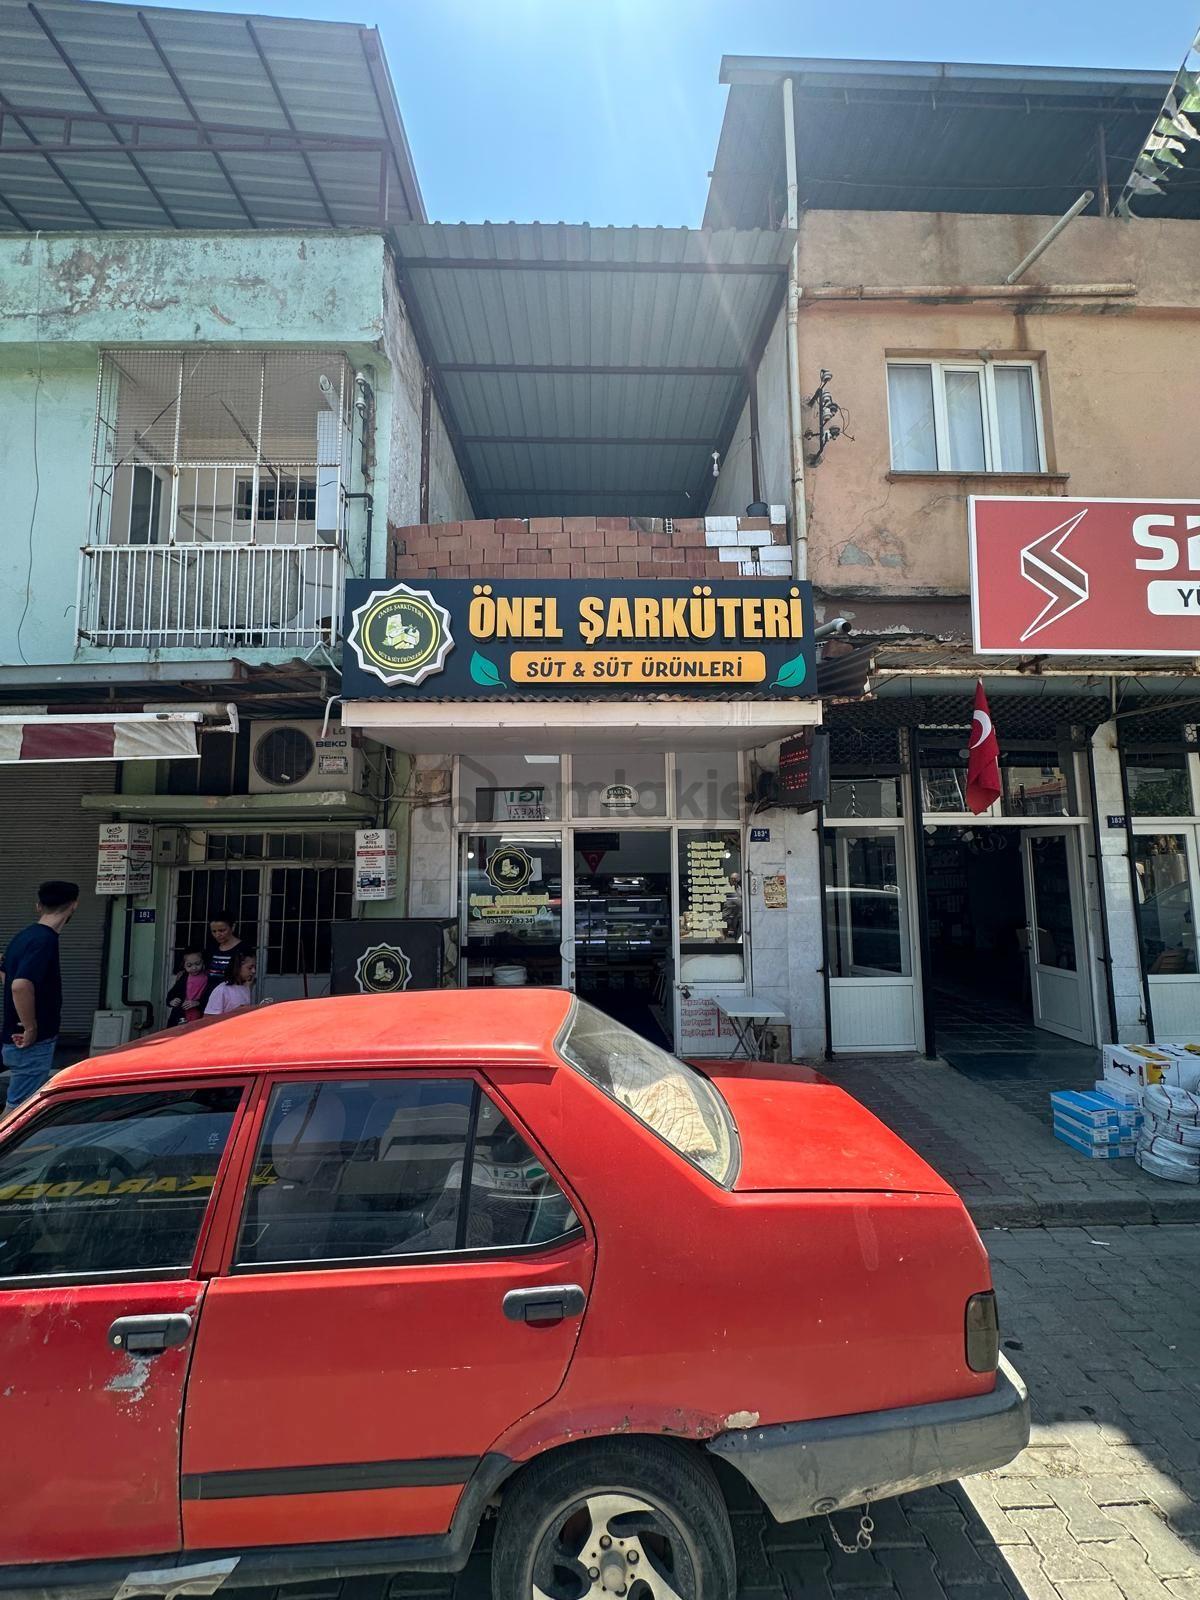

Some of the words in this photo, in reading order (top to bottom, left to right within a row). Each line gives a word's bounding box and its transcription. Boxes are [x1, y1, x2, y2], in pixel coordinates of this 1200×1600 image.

[468, 585, 564, 639] ÖNEL
[579, 585, 804, 644] ŞARKÜTERİ
[526, 656, 567, 678] SÜT
[573, 661, 586, 677] &
[592, 656, 633, 678] SÜT
[641, 656, 743, 678] ÜRÜNLERİ
